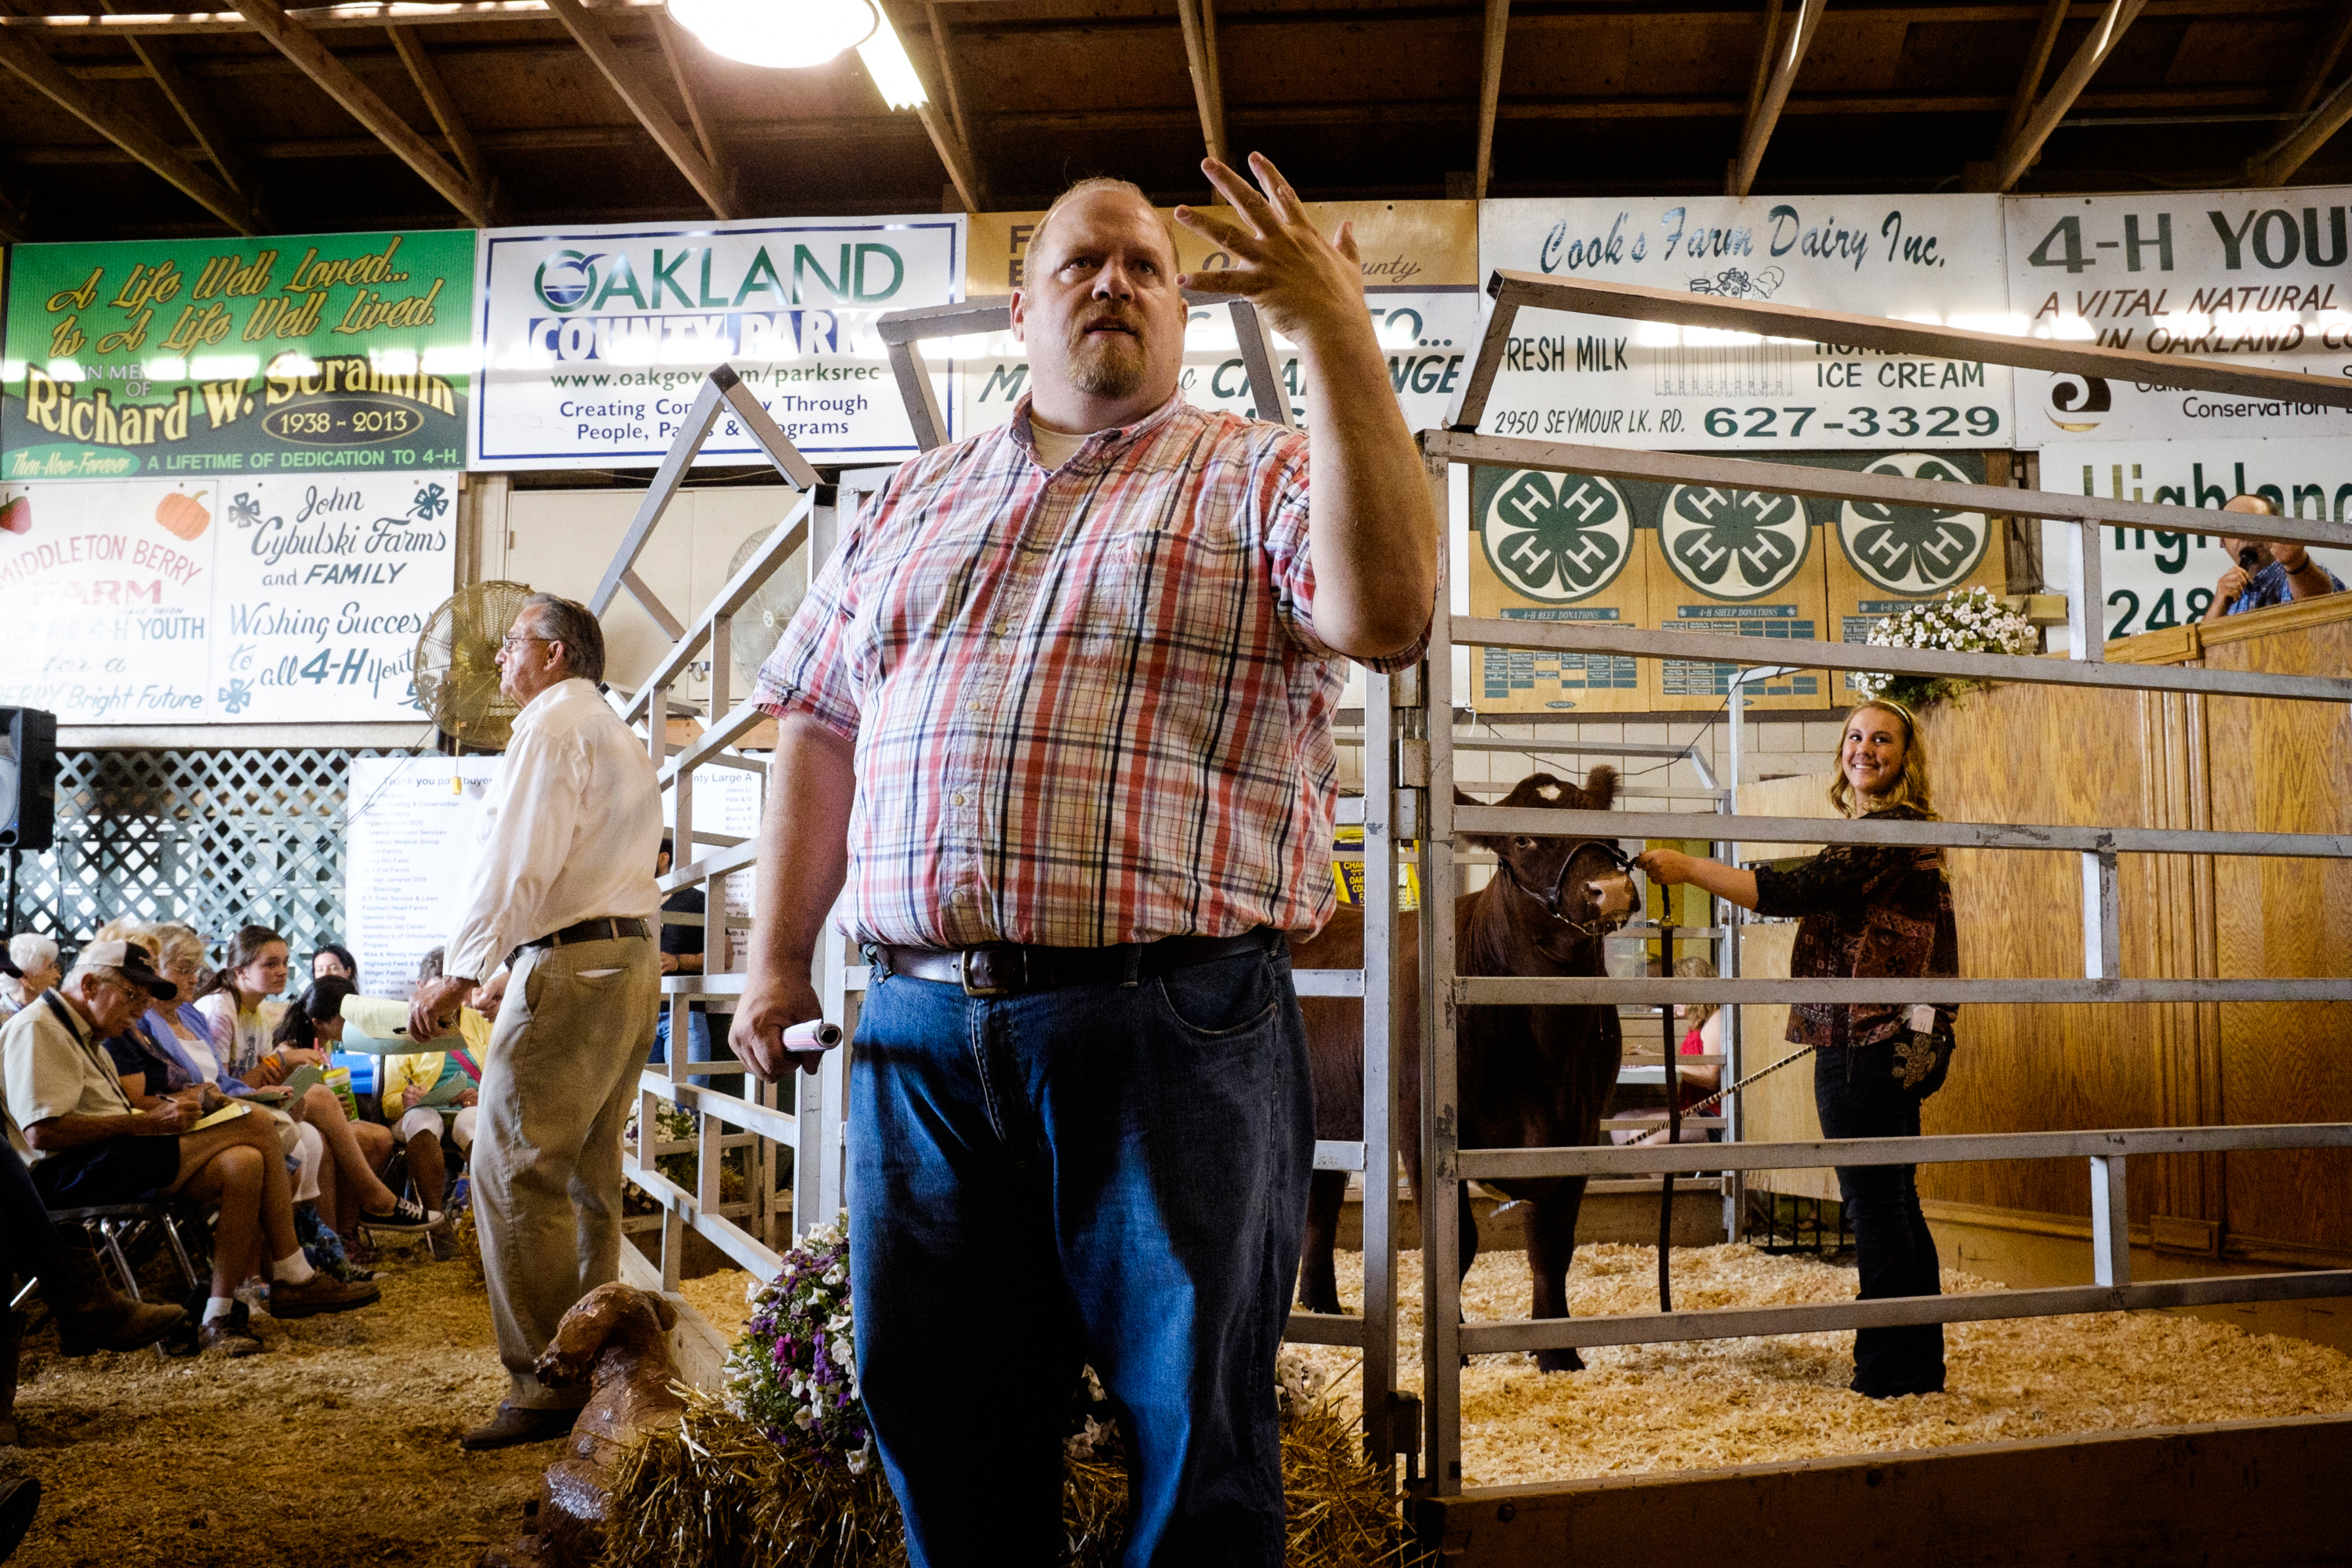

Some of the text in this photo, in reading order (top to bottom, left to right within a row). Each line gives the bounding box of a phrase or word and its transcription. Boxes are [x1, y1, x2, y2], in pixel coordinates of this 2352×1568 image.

[1541, 204, 1946, 274] Cook's Farm Dairy Inc.
[2027, 206, 2352, 273] 4-H YOU
[46, 267, 103, 312] A
[109, 260, 182, 317] Life
[191, 250, 278, 301] Well
[534, 243, 905, 312] OAKLAND
[2035, 284, 2338, 319] A VITAL NATURAL
[48, 278, 444, 361] Is A Life Well Lived.
[530, 314, 726, 361] COUNTY
[2096, 328, 2133, 350] IN
[2146, 324, 2305, 354] OAKLAND
[1501, 336, 1628, 372] RESH MILK
[125, 381, 151, 397] OF
[1817, 361, 1984, 390] ICE CREAM
[27, 366, 188, 445] Richard
[201, 375, 254, 429] W.
[560, 399, 645, 422] Creating
[783, 394, 869, 418] Through
[2183, 396, 2328, 418] Conservation
[280, 412, 331, 434] 1938
[353, 410, 408, 432] 2013
[577, 423, 649, 446] People,
[724, 420, 740, 436] &
[1494, 408, 1686, 435] 2950 SEYMOUR LK. RD.
[1704, 406, 2000, 438] 627-3329
[147, 454, 159, 470] A
[166, 453, 243, 470] LIFETIME
[250, 452, 274, 469] OF
[281, 451, 385, 468] DEDICATION
[392, 448, 416, 465] TO
[296, 485, 364, 523] John
[250, 514, 447, 566] Cybulski Farms
[0, 534, 203, 590] MIDDLETON BERRY
[262, 562, 408, 586] and FAMILY
[32, 579, 162, 605] FARM
[153, 607, 185, 615] ORION
[229, 601, 433, 644] Wishing Succes
[1537, 611, 1556, 619] BEEF
[1558, 610, 1600, 619] DONATIONS
[1714, 608, 1737, 617] SHEEP
[1738, 607, 1778, 617] DONATIONS
[137, 616, 205, 640] YOUTH
[105, 657, 126, 673] a
[223, 644, 418, 699] to all 4-H yout
[67, 684, 133, 717] Bright
[137, 684, 203, 709] Future
[416, 778, 434, 787] you
[712, 774, 742, 784] Large
